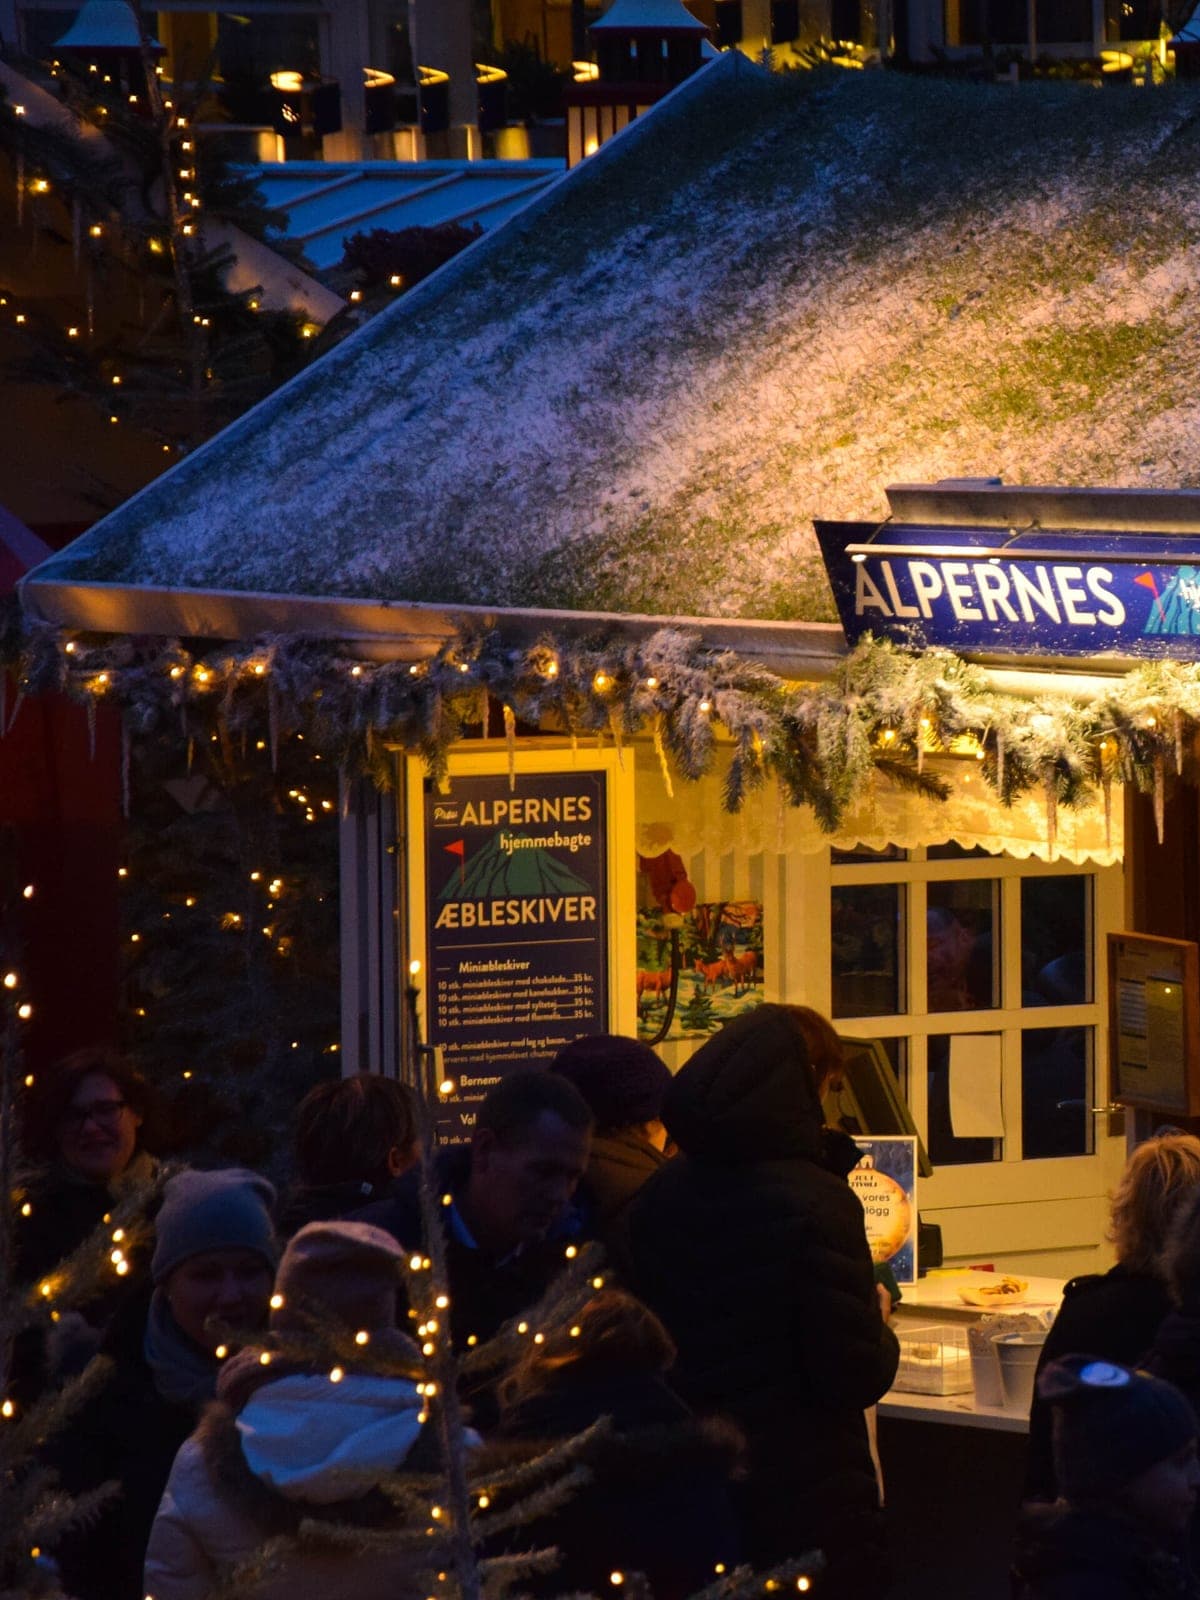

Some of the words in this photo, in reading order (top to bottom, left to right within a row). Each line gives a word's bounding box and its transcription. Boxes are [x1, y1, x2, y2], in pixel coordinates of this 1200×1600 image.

[855, 559, 1126, 626] ALPERNES
[459, 796, 593, 826] ALPERNES
[500, 831, 593, 855] hjemmebagte
[434, 896, 597, 929] ÆBLESKIVER
[458, 959, 530, 973] Miniæbleskiver
[865, 1206, 890, 1217] lögg
